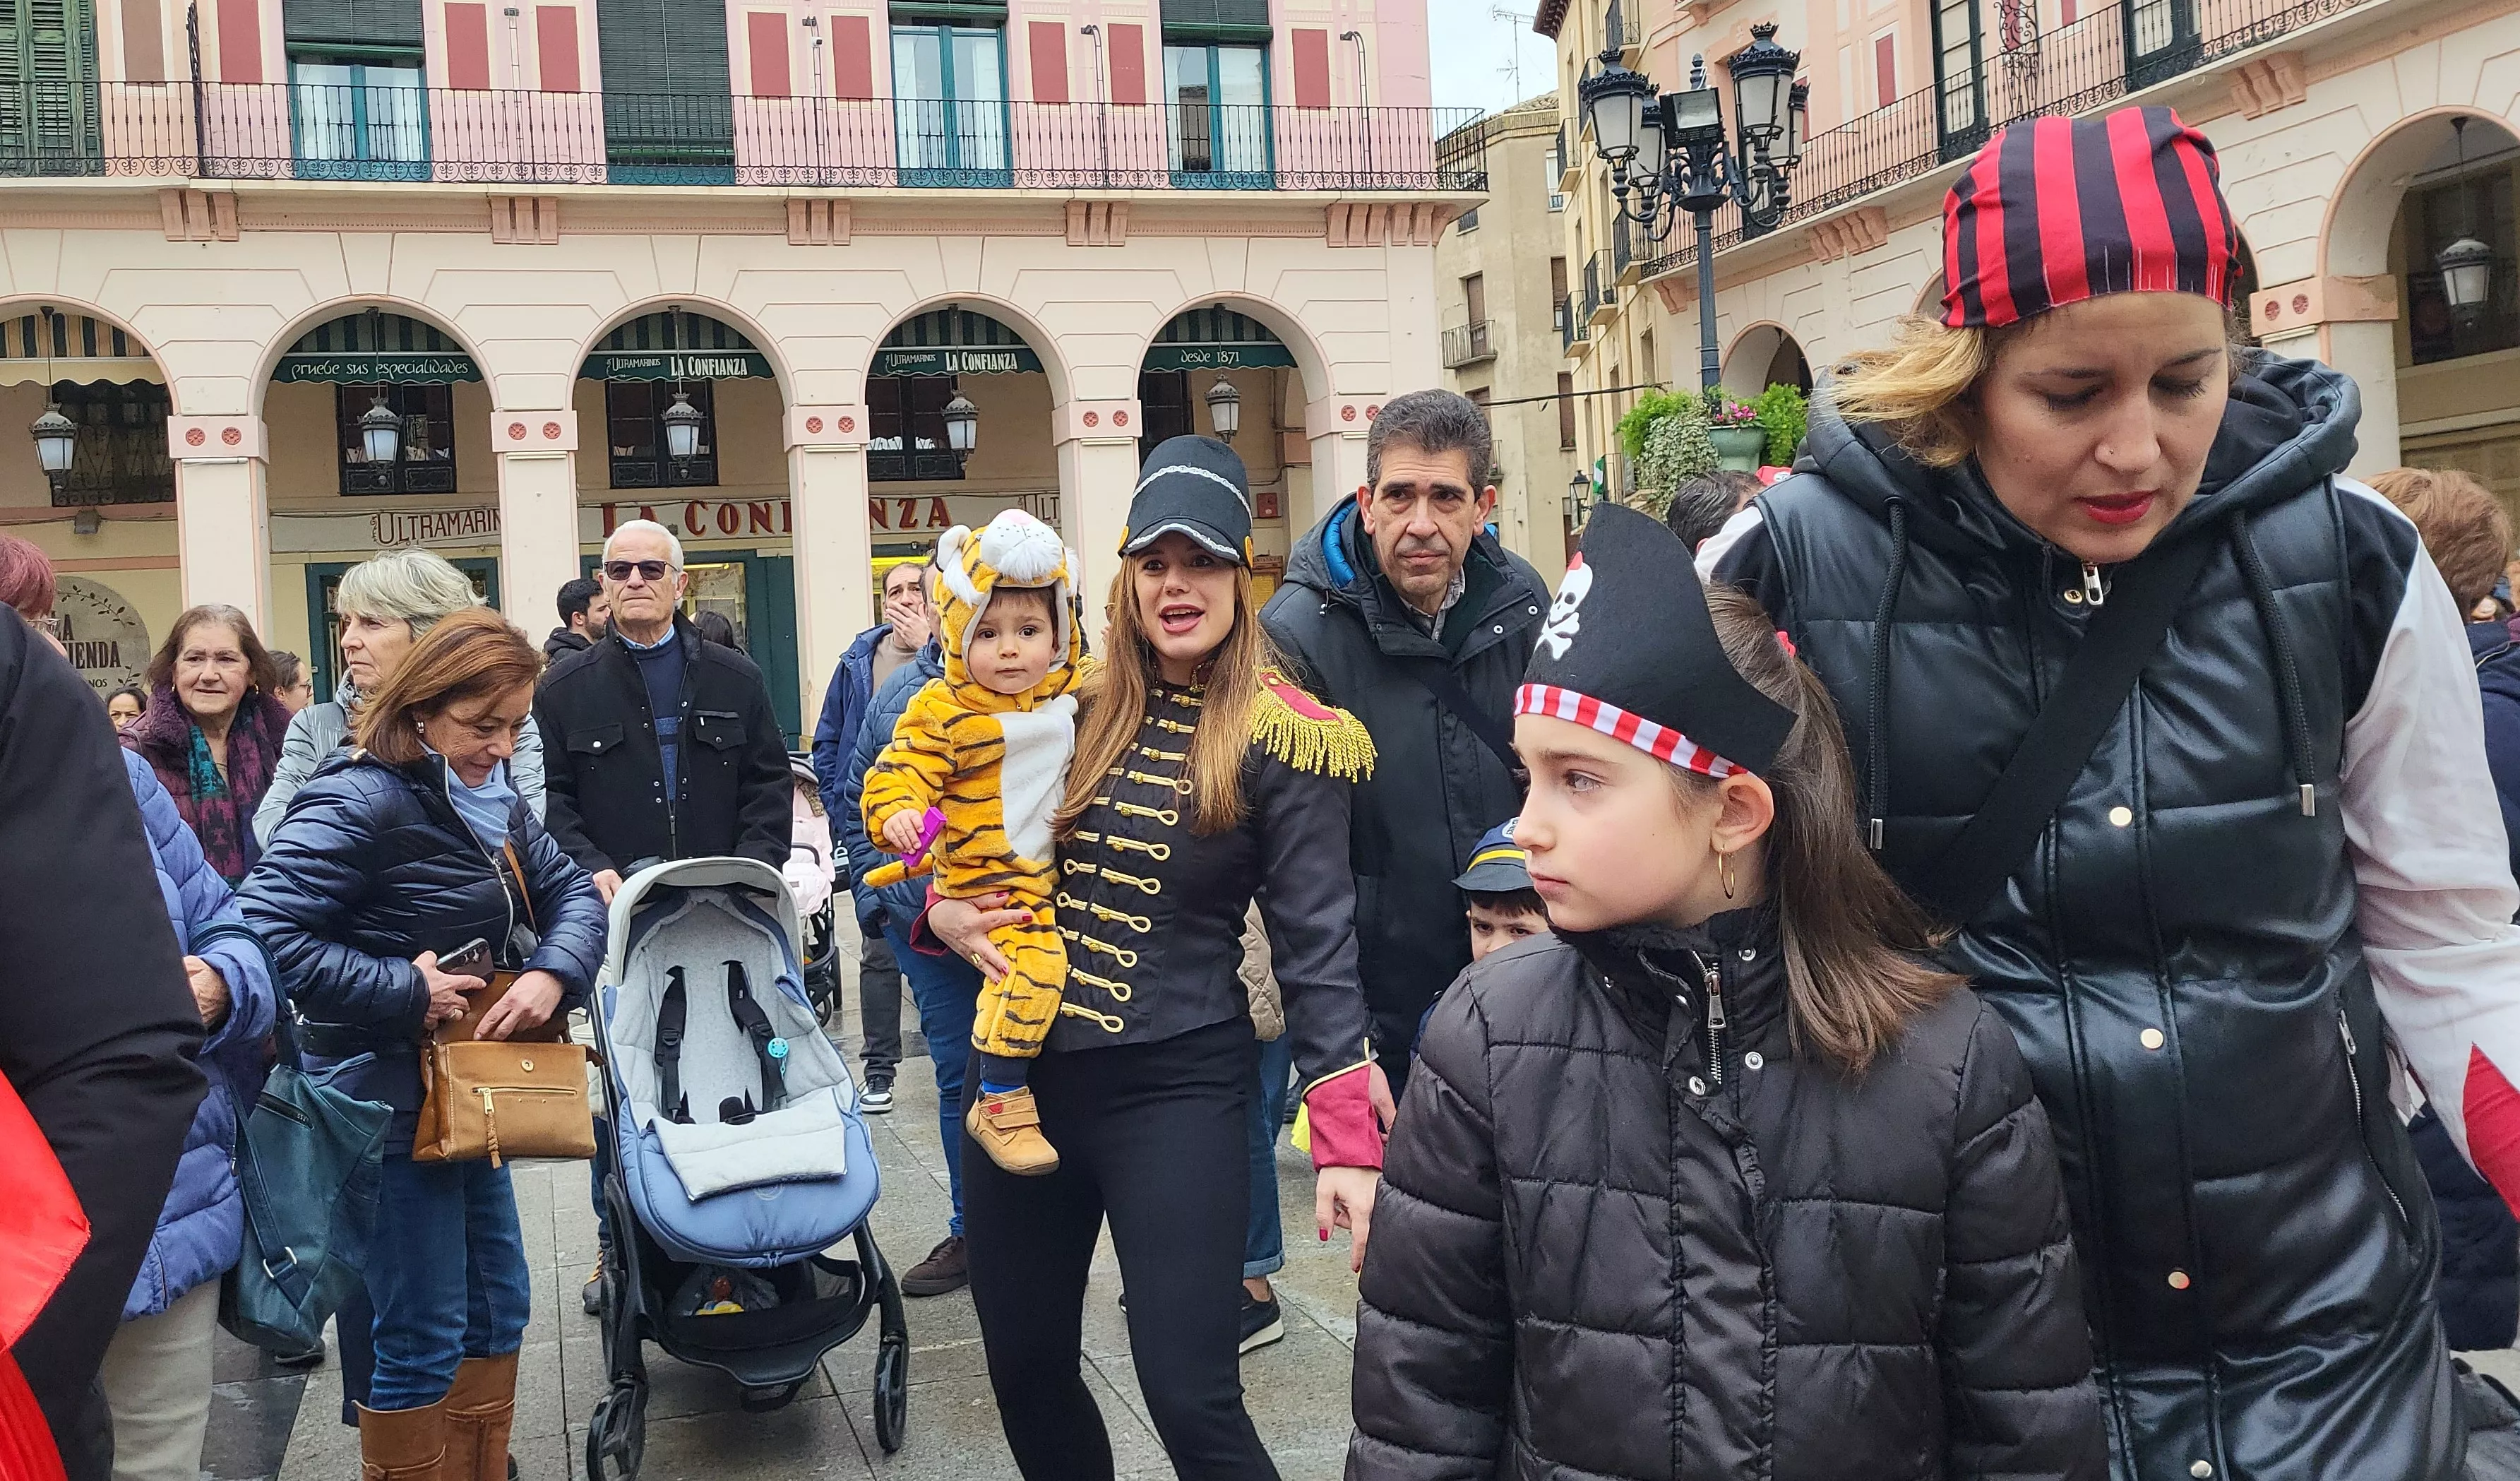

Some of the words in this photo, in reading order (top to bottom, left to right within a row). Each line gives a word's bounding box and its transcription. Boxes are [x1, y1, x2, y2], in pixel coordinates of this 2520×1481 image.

[670, 357, 685, 376] LA
[688, 356, 748, 376] CONFIANZA
[945, 352, 958, 371] LA
[962, 352, 1017, 371] CONFIANZA
[1181, 349, 1211, 362] desde
[1217, 350, 1240, 364] 1871
[292, 360, 340, 379] pruebe
[346, 363, 369, 374] sus
[376, 359, 468, 380] especialidades
[378, 508, 501, 544] ULTRAMARIN
